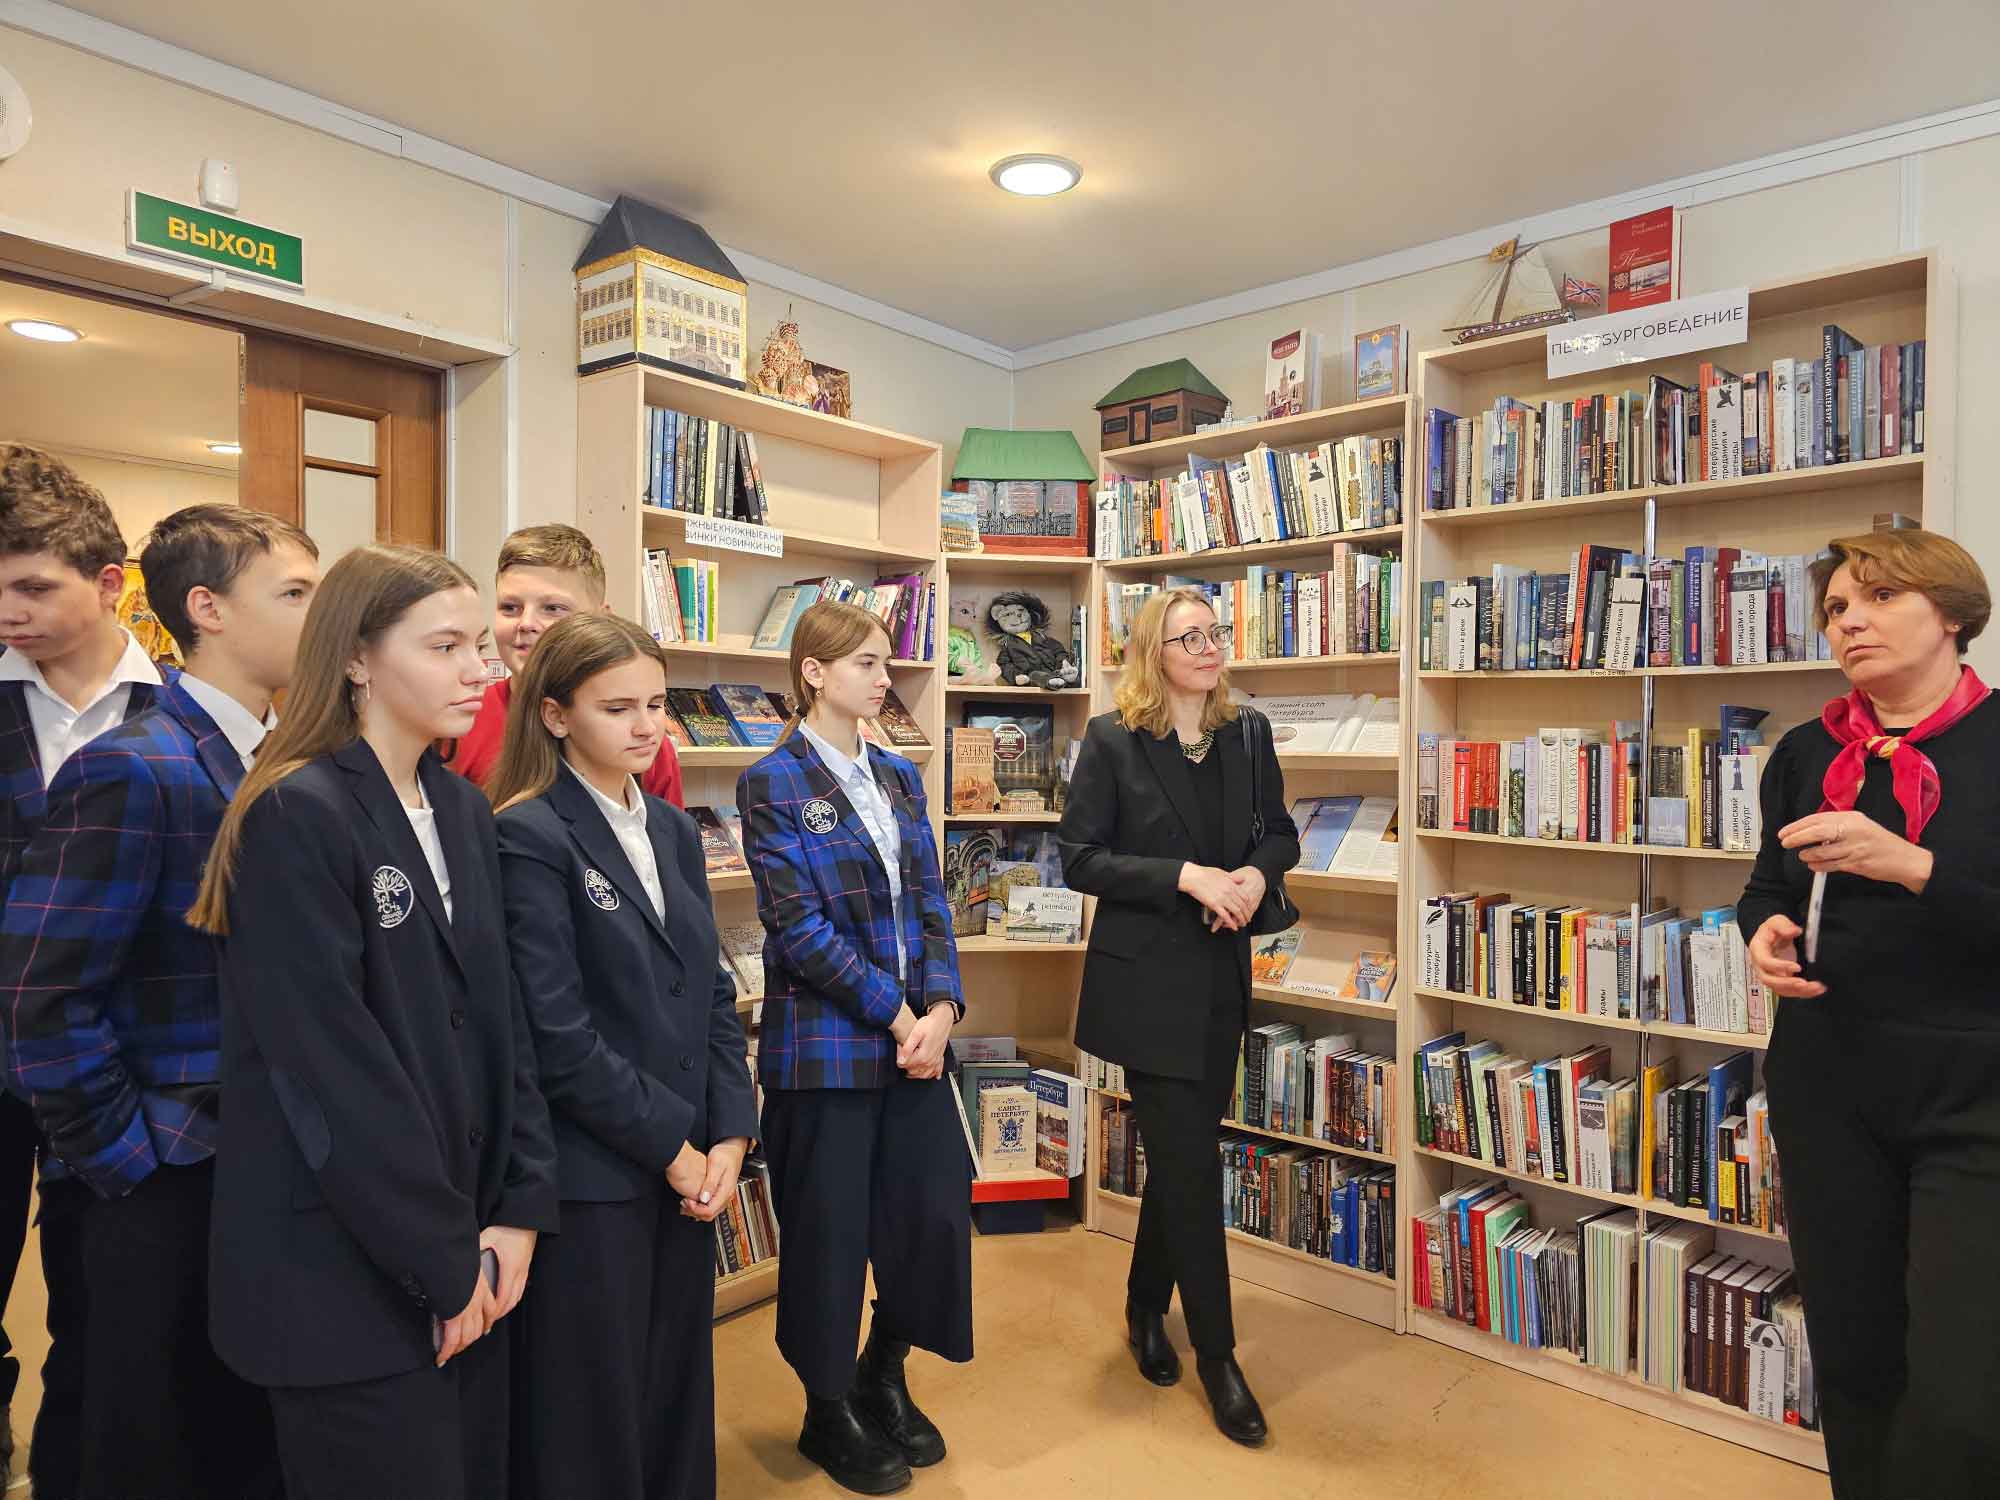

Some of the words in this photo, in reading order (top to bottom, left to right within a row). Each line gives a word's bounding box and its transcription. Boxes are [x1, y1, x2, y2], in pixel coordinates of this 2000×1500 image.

[167, 216, 277, 267] ВЫХОД
[1551, 306, 1745, 356] ПЕБУРГОВЕДЕНИЕ
[1824, 335, 1832, 387] МИСТИЧЕСКИЙ
[1710, 419, 1719, 481] Петербургские
[1720, 438, 1729, 480] предания
[1748, 593, 1757, 624] города
[1611, 608, 1624, 669] Петроградская
[1621, 636, 1630, 669] сторона
[1737, 617, 1746, 650] улицам
[1748, 625, 1757, 663] районам
[1736, 652, 1745, 663] По
[1731, 797, 1740, 850] Пшкинский
[1424, 934, 1433, 987] Литературный
[1432, 949, 1441, 988] Петербург
[1598, 989, 1607, 1017] Храмы
